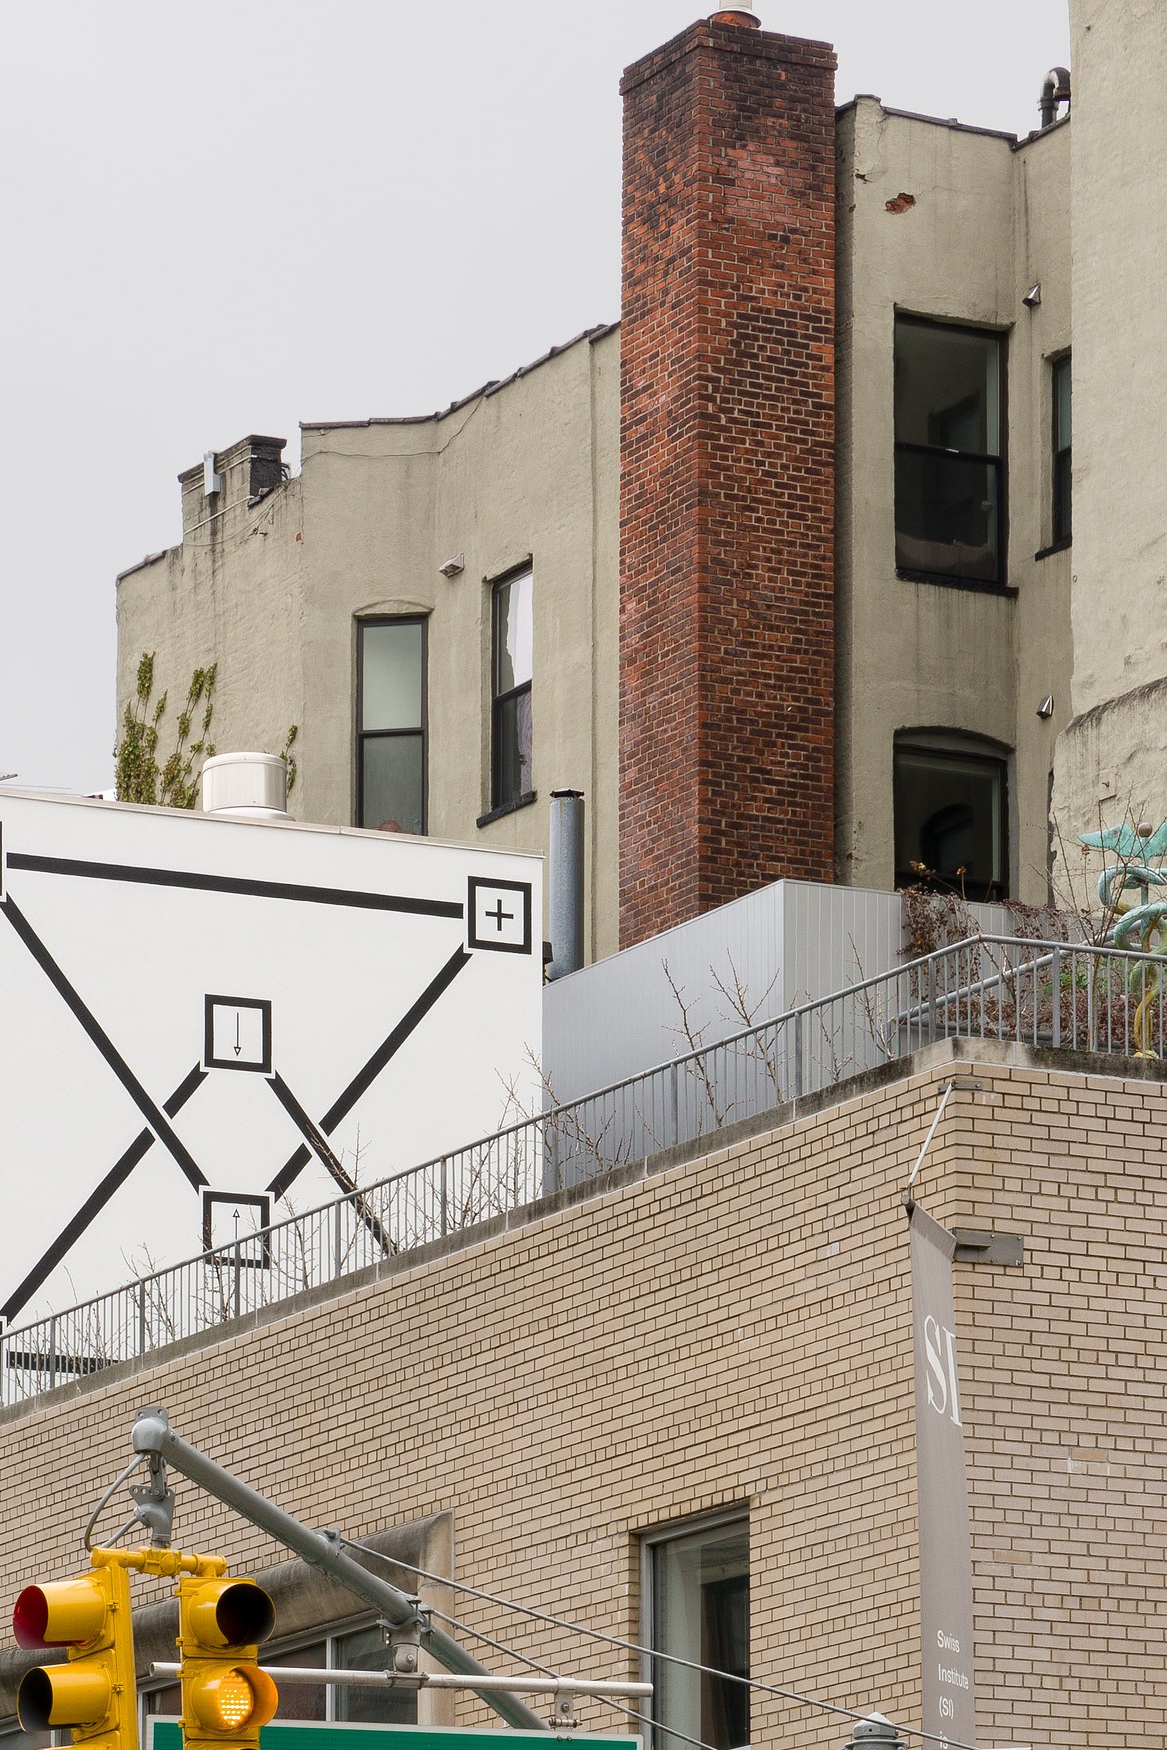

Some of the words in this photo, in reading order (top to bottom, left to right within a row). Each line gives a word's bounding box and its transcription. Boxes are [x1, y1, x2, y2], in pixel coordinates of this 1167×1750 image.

[924, 1314, 963, 1427] SI
[936, 1629, 960, 1654] Swiss
[937, 1663, 970, 1691] Institute
[938, 1695, 955, 1721] (SI)
